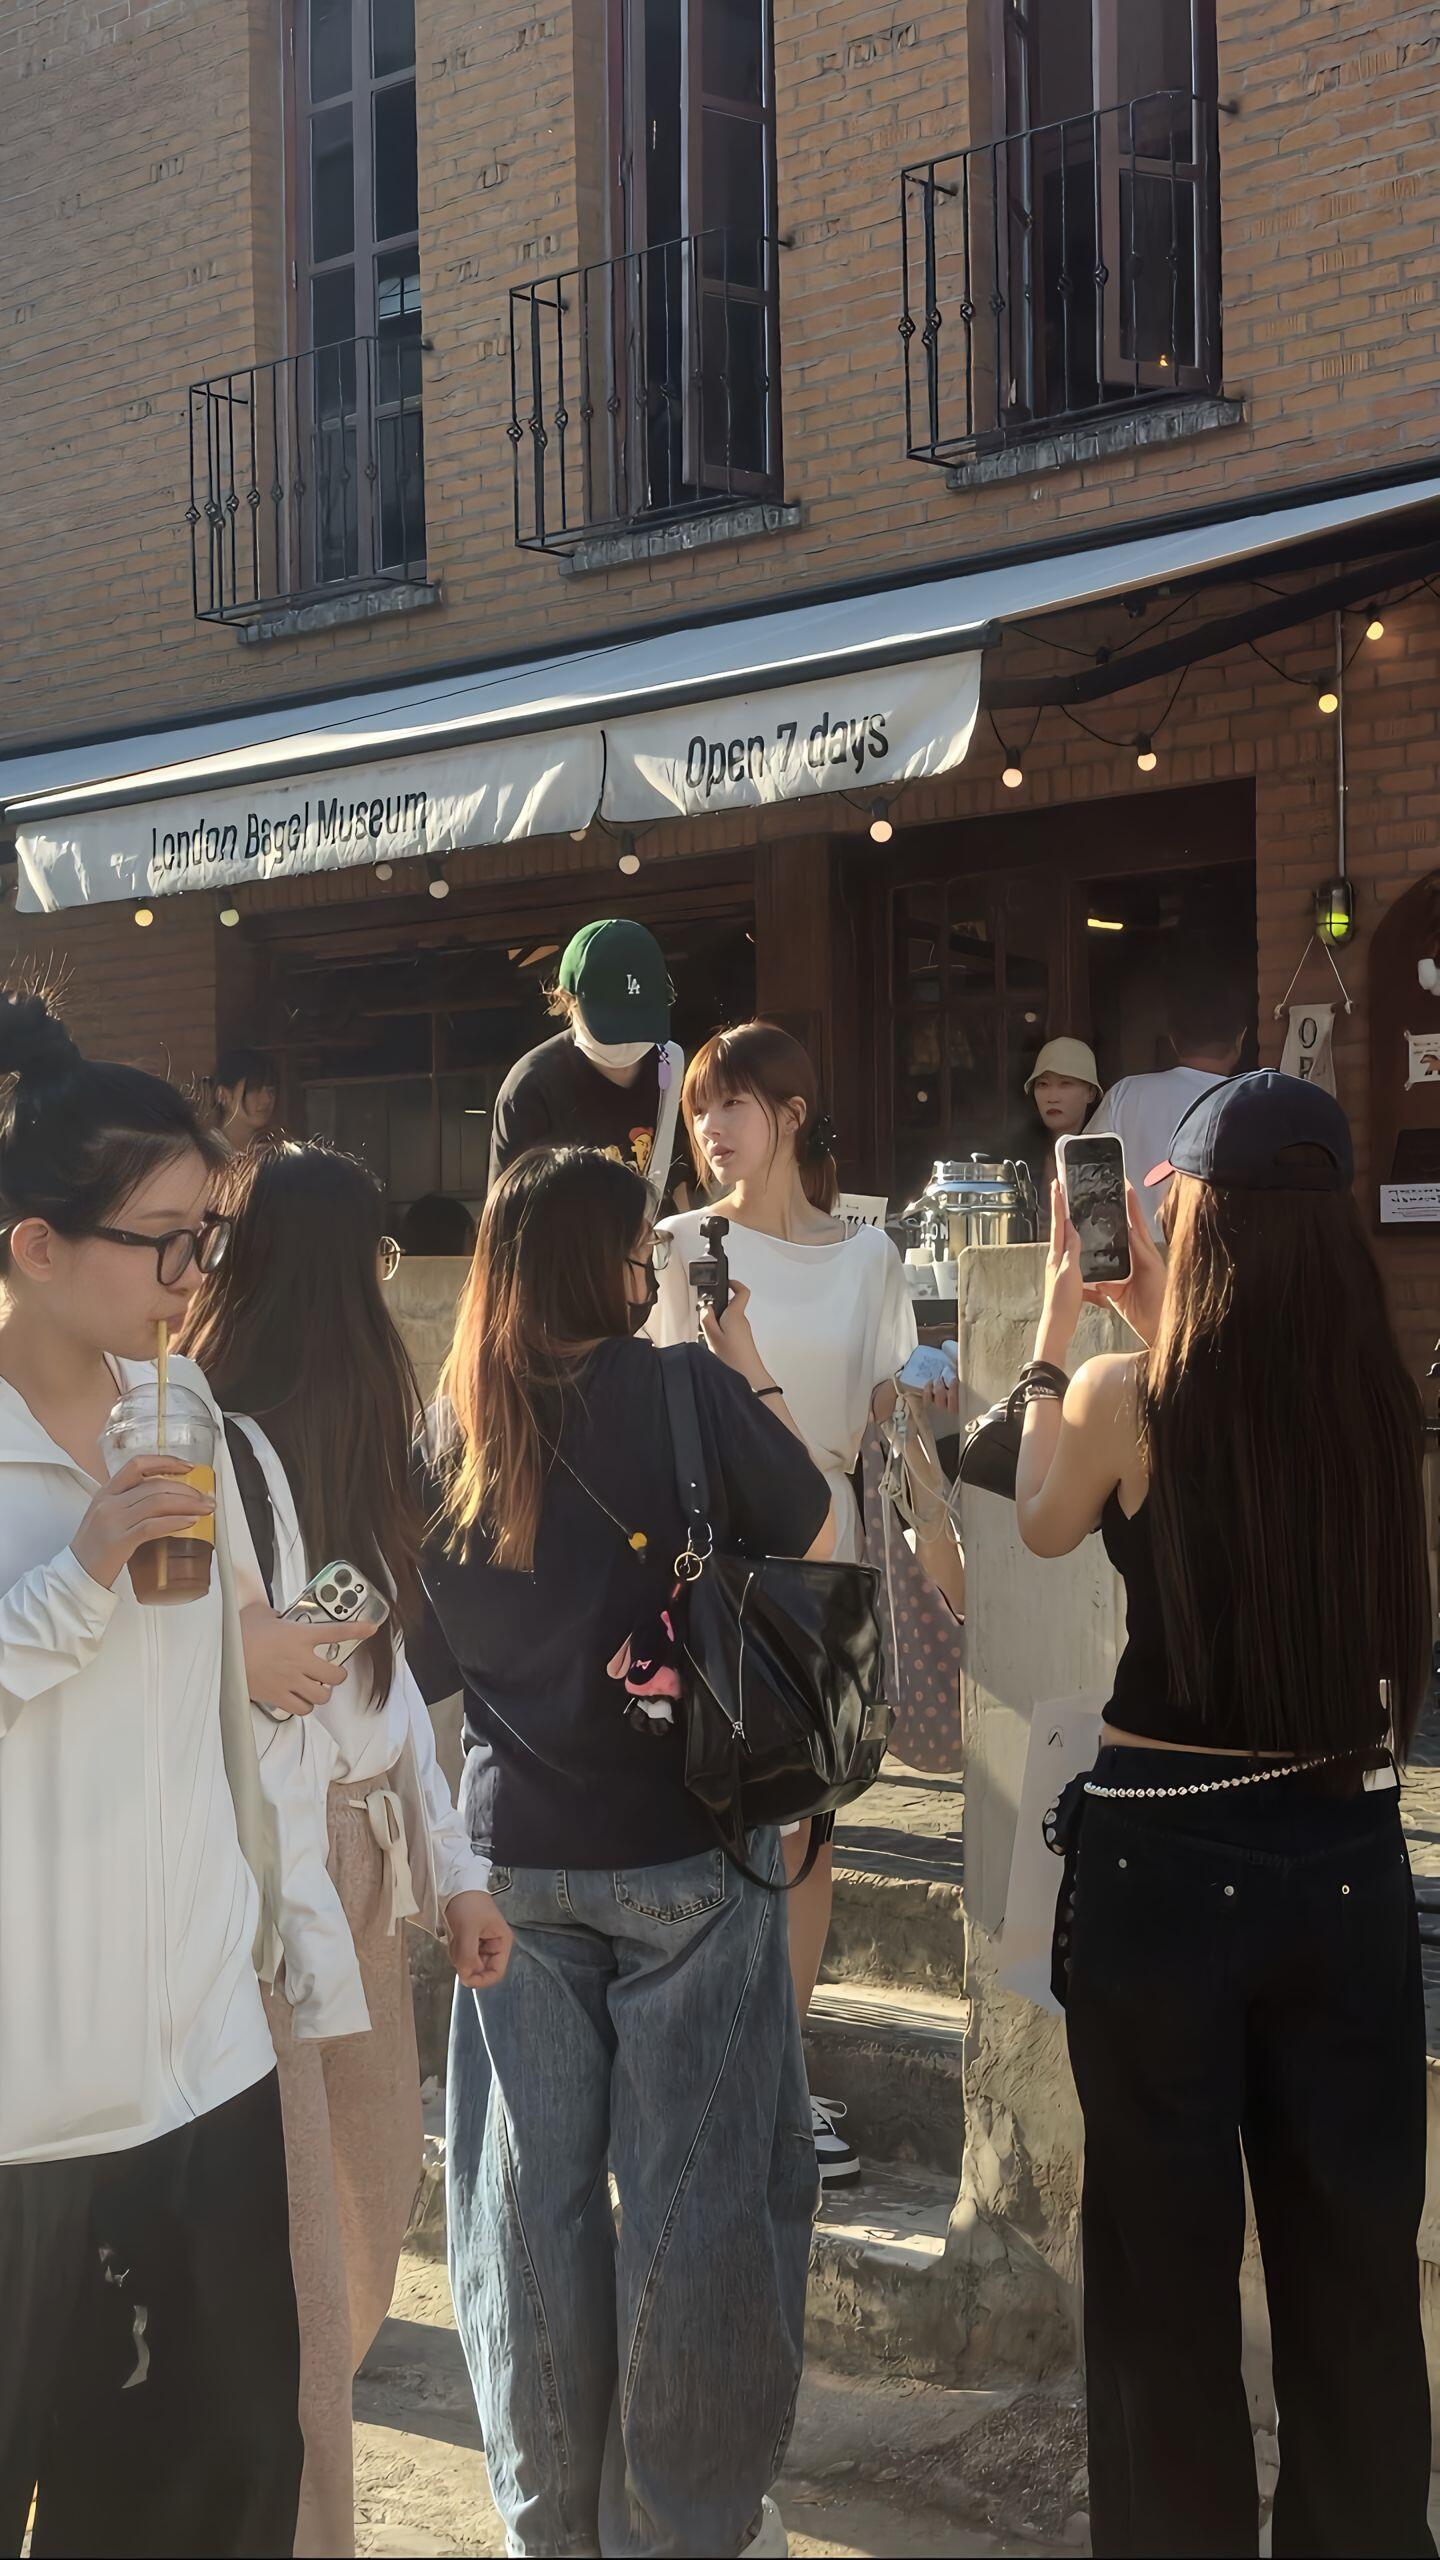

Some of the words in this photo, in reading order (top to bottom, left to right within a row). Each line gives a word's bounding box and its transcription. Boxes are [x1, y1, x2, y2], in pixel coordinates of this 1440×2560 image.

[686, 735, 764, 797] Open
[777, 721, 797, 773] 7
[808, 712, 889, 774] days
[152, 818, 238, 873] London
[245, 801, 310, 864] Bagel
[317, 791, 428, 847] Museum
[627, 974, 640, 994] LA
